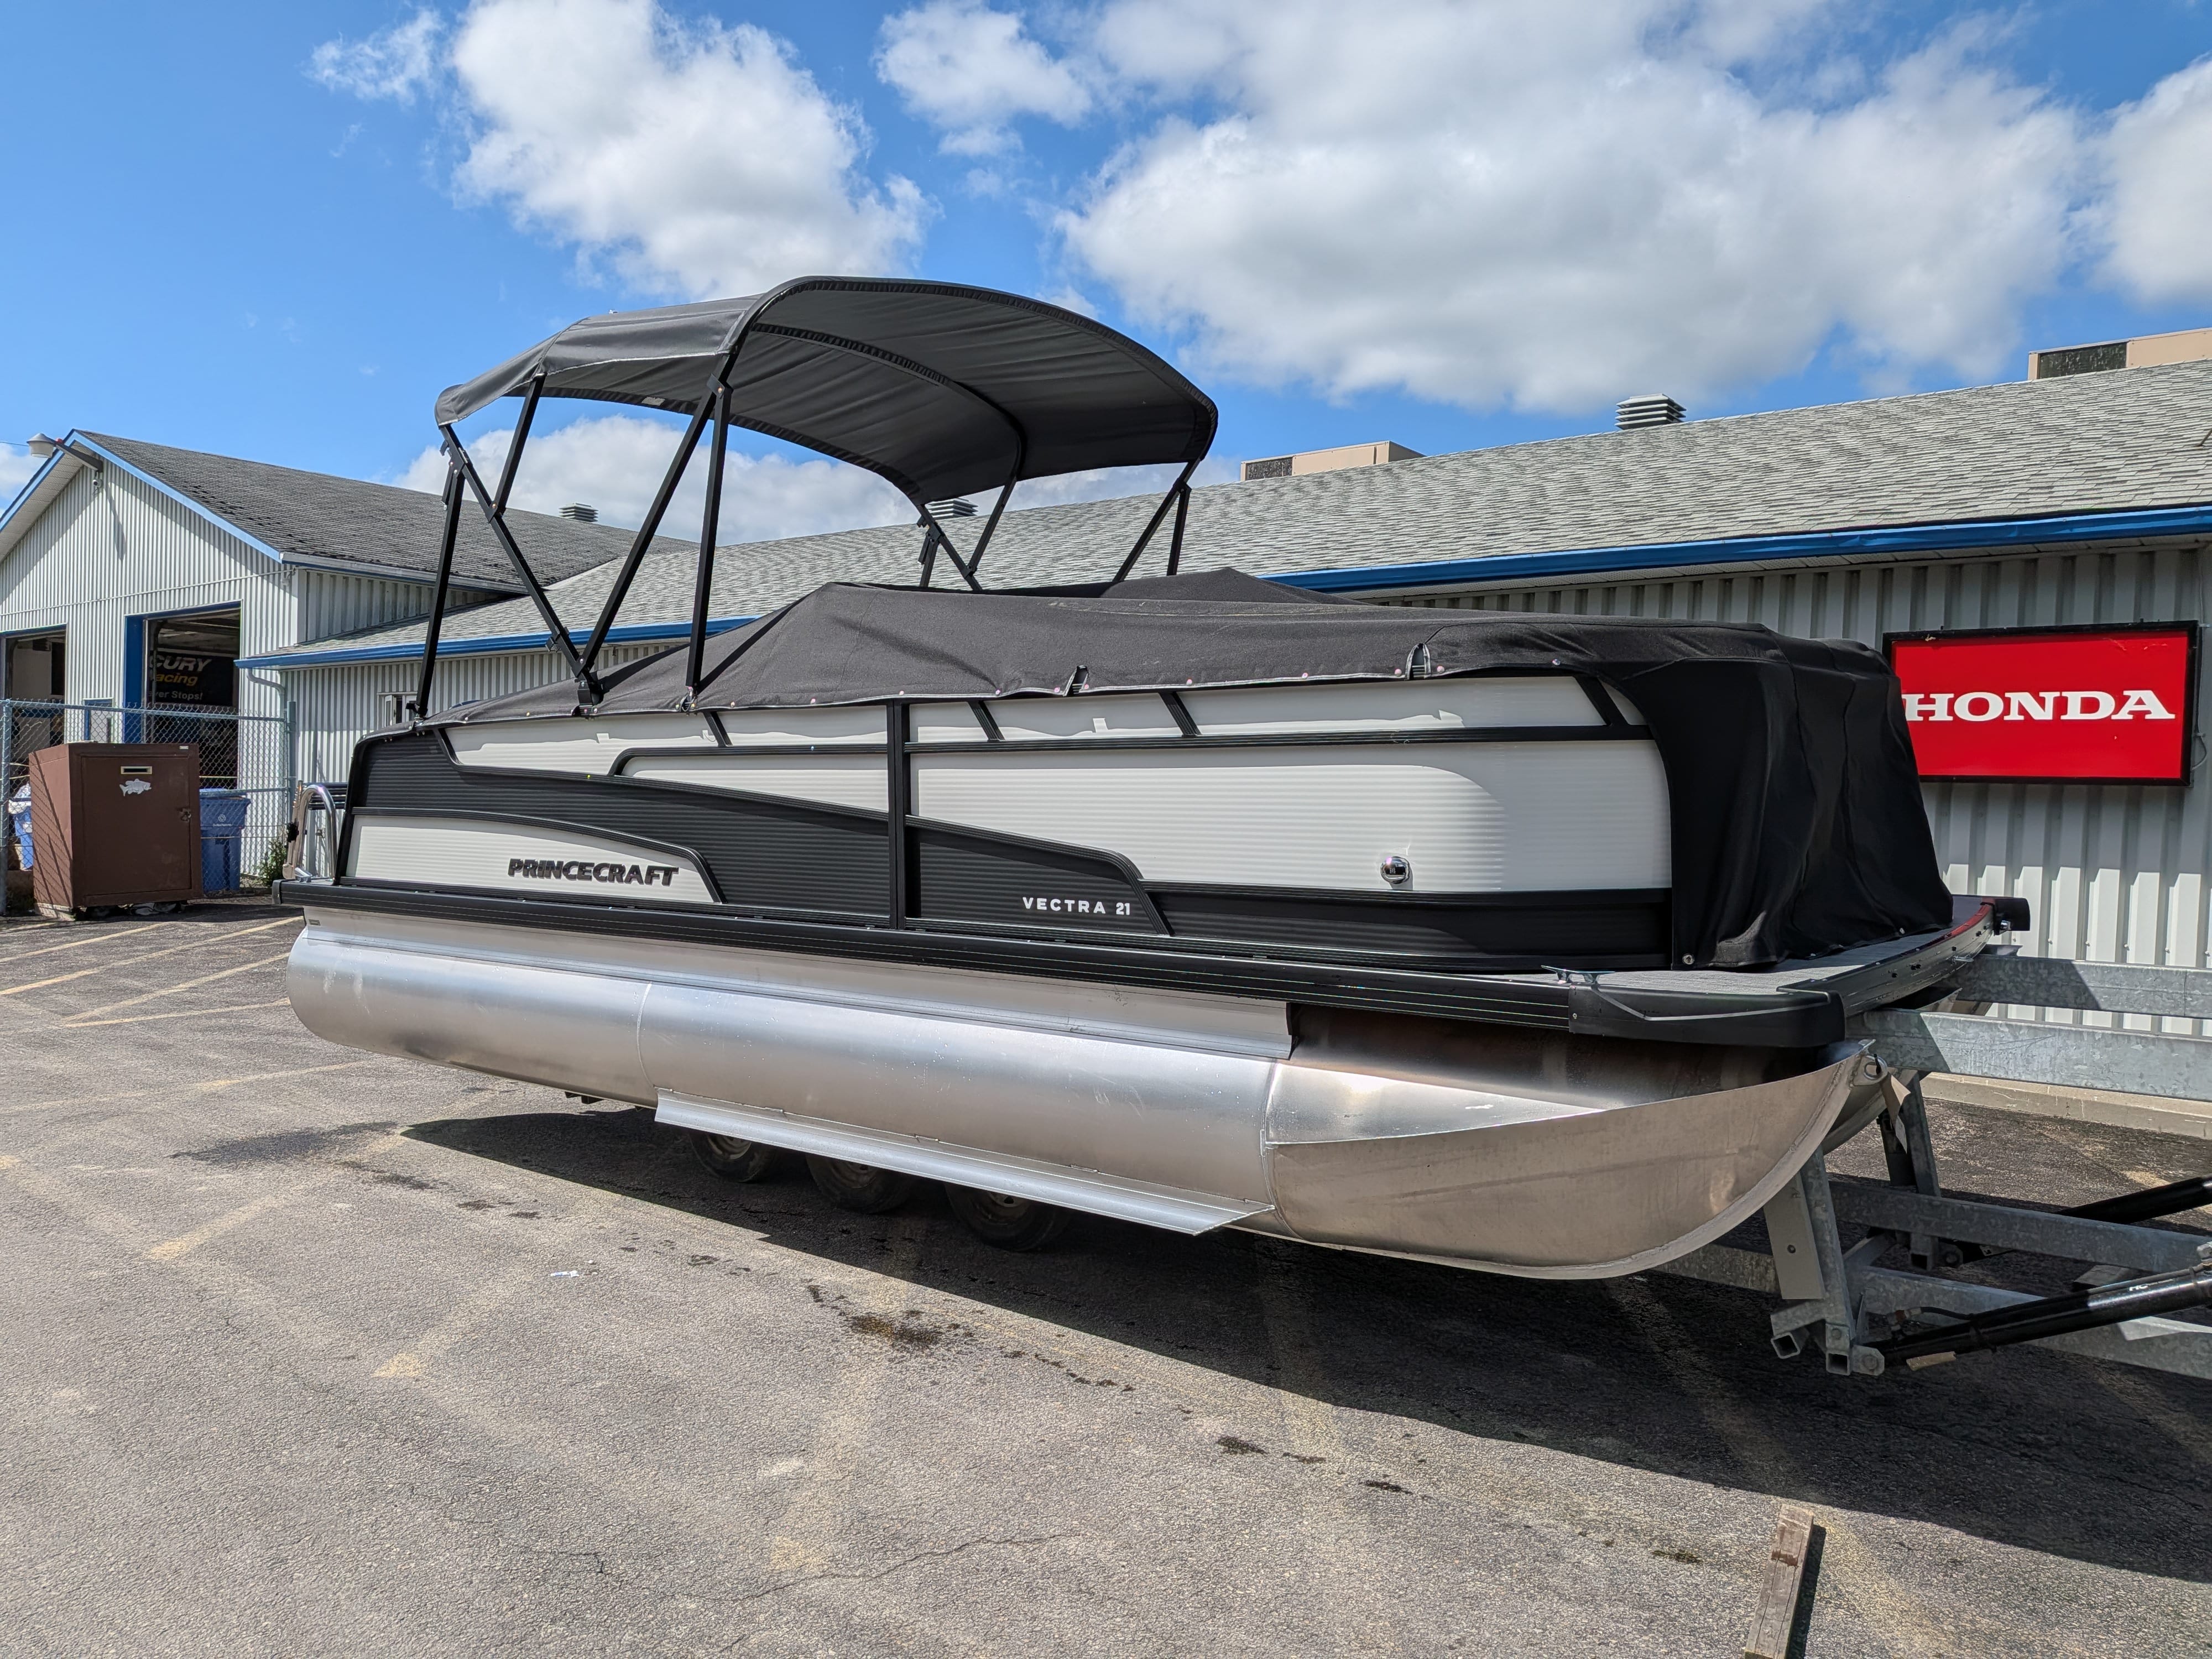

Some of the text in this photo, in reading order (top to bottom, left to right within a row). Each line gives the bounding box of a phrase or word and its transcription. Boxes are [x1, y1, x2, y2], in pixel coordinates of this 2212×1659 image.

[149, 655, 212, 672] CURY
[171, 690, 204, 701] Stops!
[1901, 690, 2176, 722] HONDA
[508, 858, 679, 886] PRINCECRAFT
[1022, 896, 1131, 916] VECTRA 21
